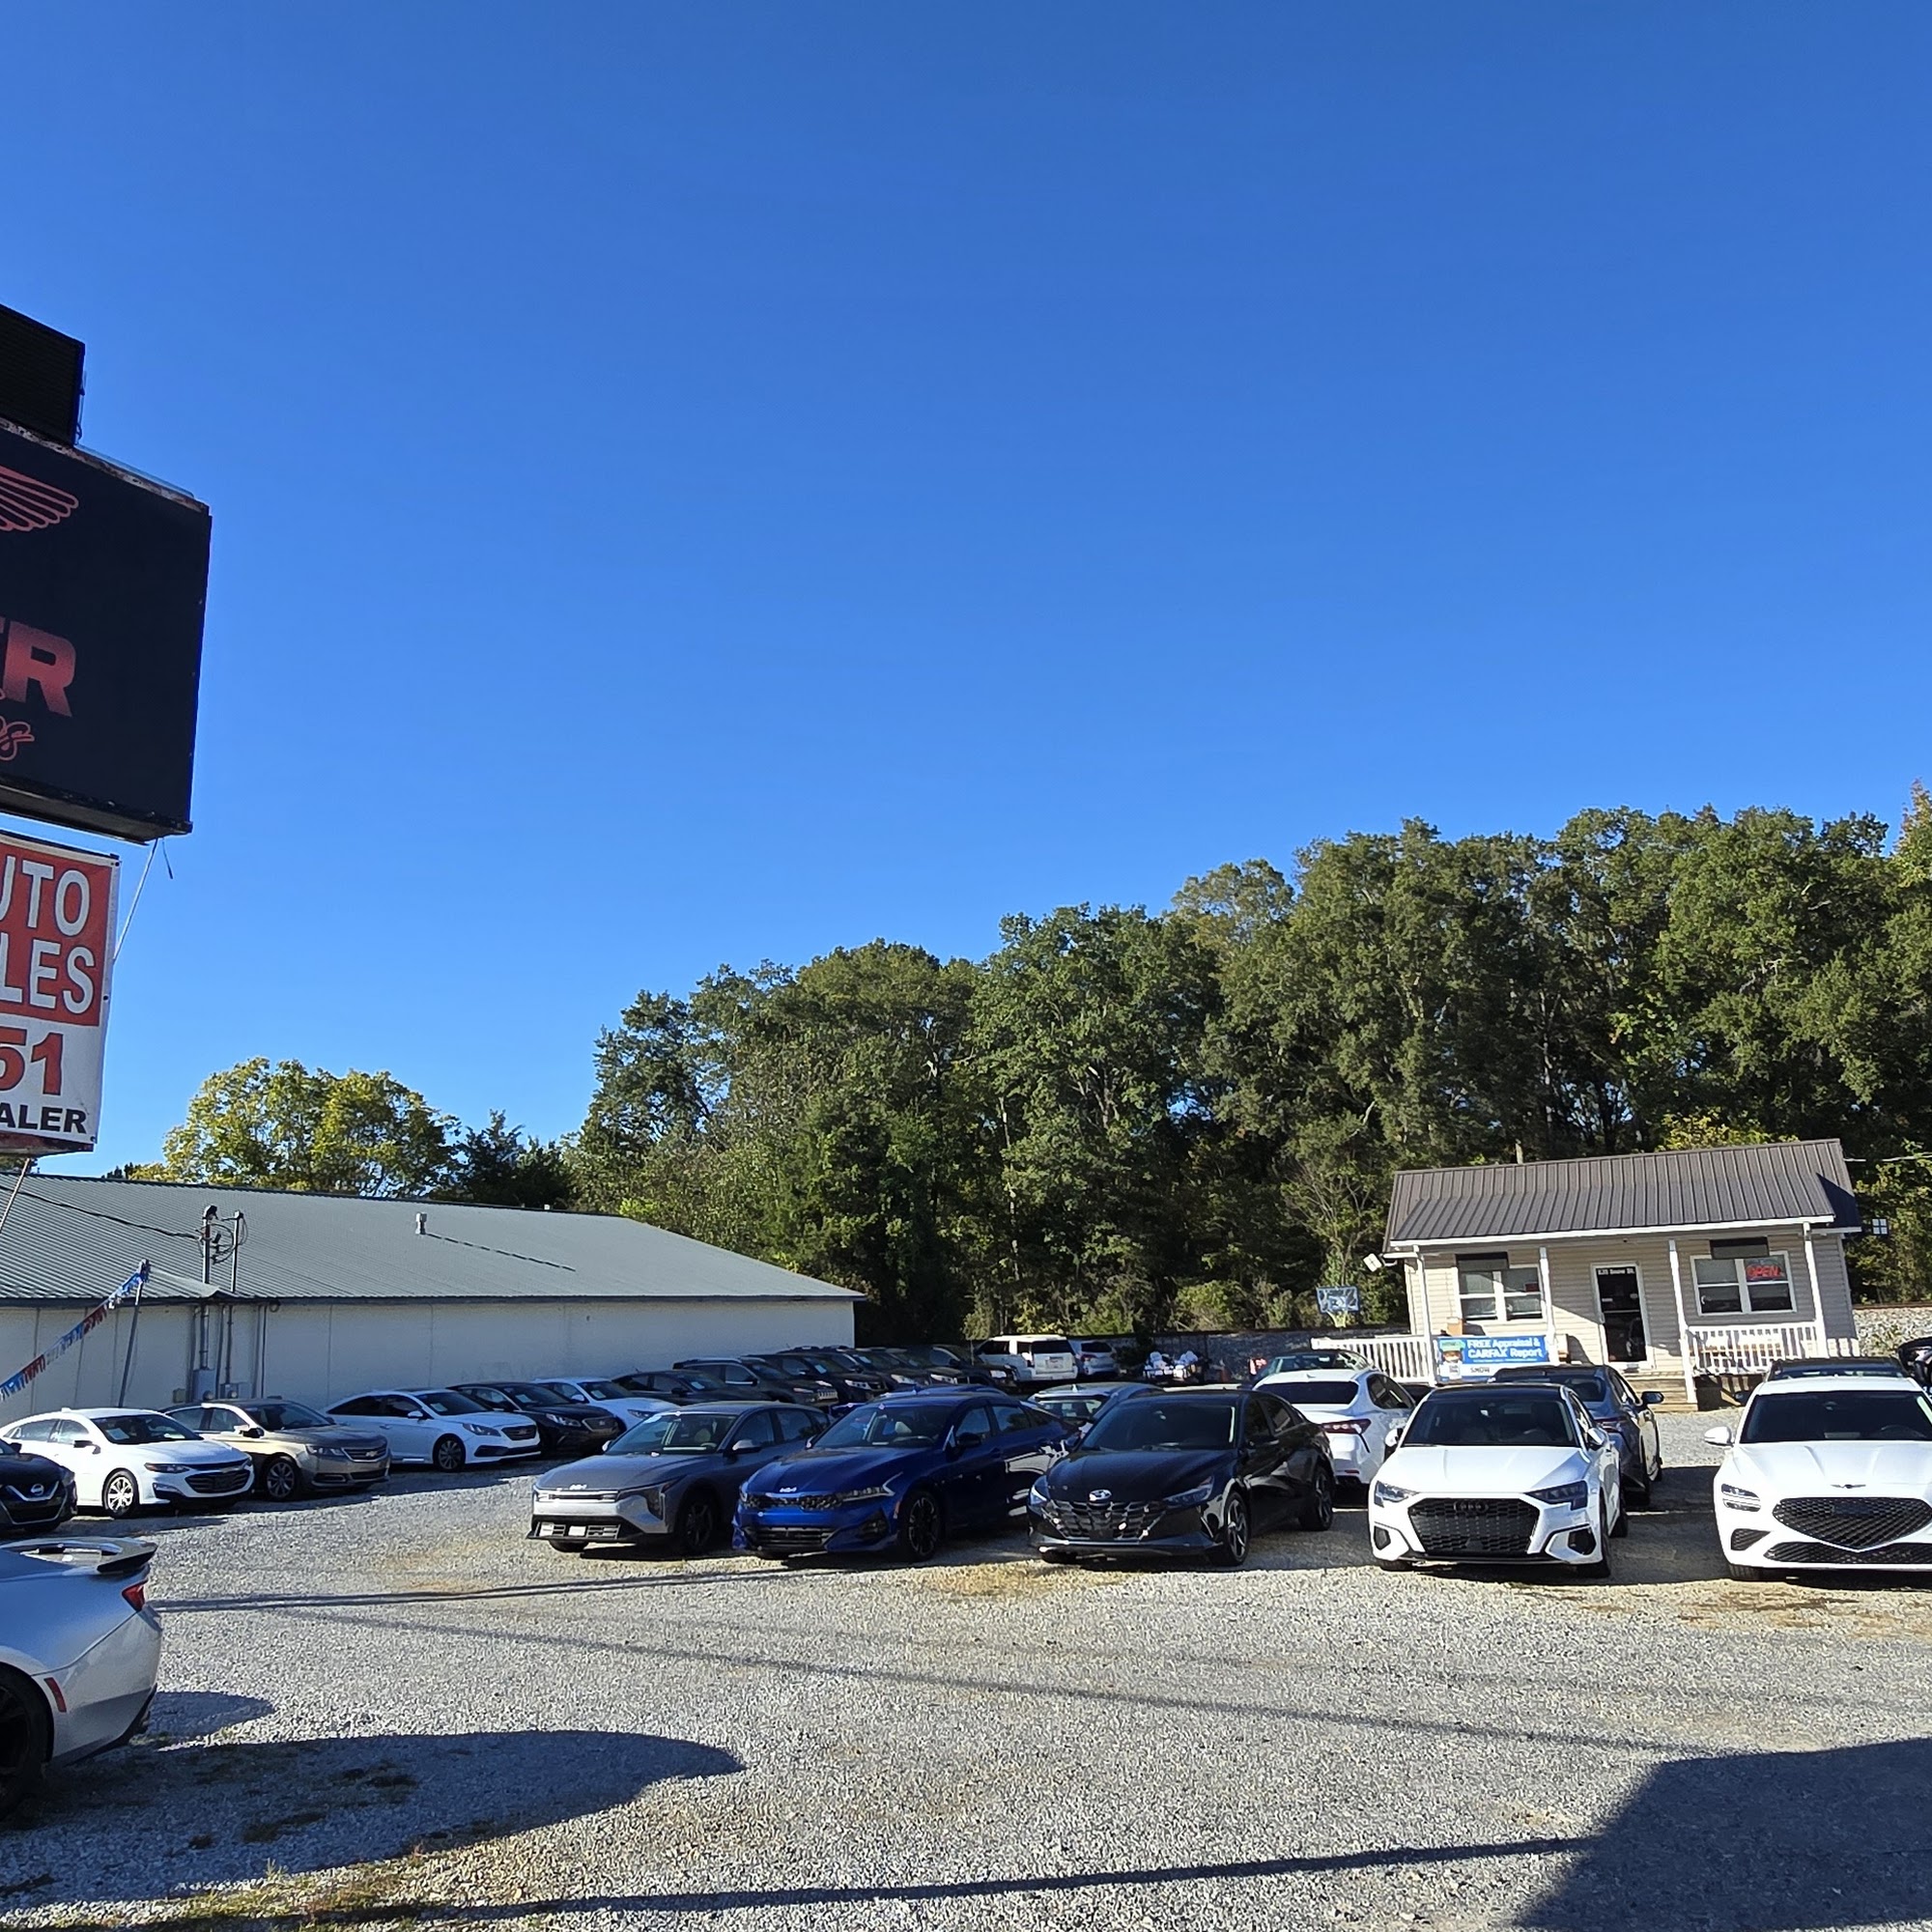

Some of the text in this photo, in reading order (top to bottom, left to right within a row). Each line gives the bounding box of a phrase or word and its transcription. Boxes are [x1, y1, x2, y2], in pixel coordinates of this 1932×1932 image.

[0, 616, 76, 717] R
[0, 1026, 63, 1095] 51
[0, 1102, 87, 1133] ALER
[1747, 1264, 1781, 1277] OPEN
[1466, 1339, 1492, 1350] FREE
[1492, 1338, 1532, 1350] Appraisal
[1467, 1348, 1544, 1358] CARFAX Report
